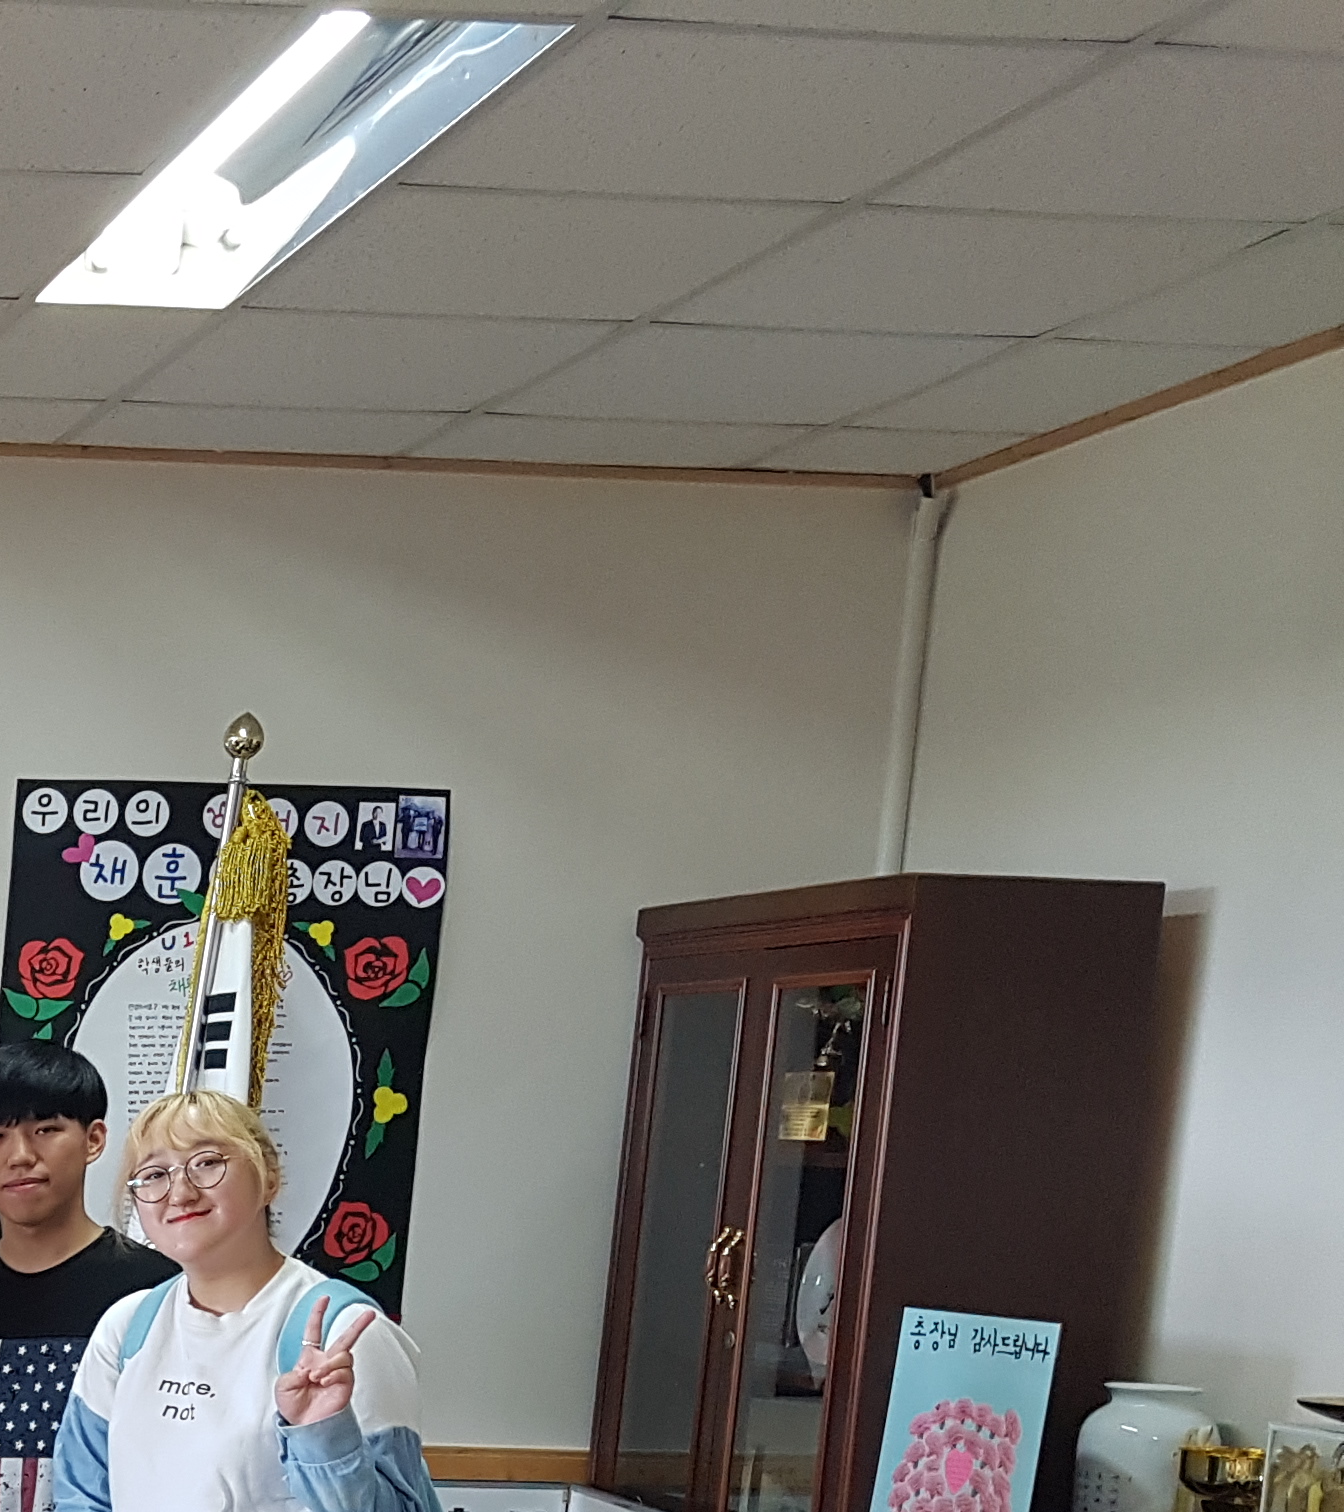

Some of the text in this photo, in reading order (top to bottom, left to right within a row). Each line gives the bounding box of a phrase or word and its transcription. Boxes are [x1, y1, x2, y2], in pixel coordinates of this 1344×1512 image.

[31, 793, 161, 826] 우리의
[909, 1315, 1050, 1363] 총장님 감사드립니다
[162, 1403, 195, 1420] not
